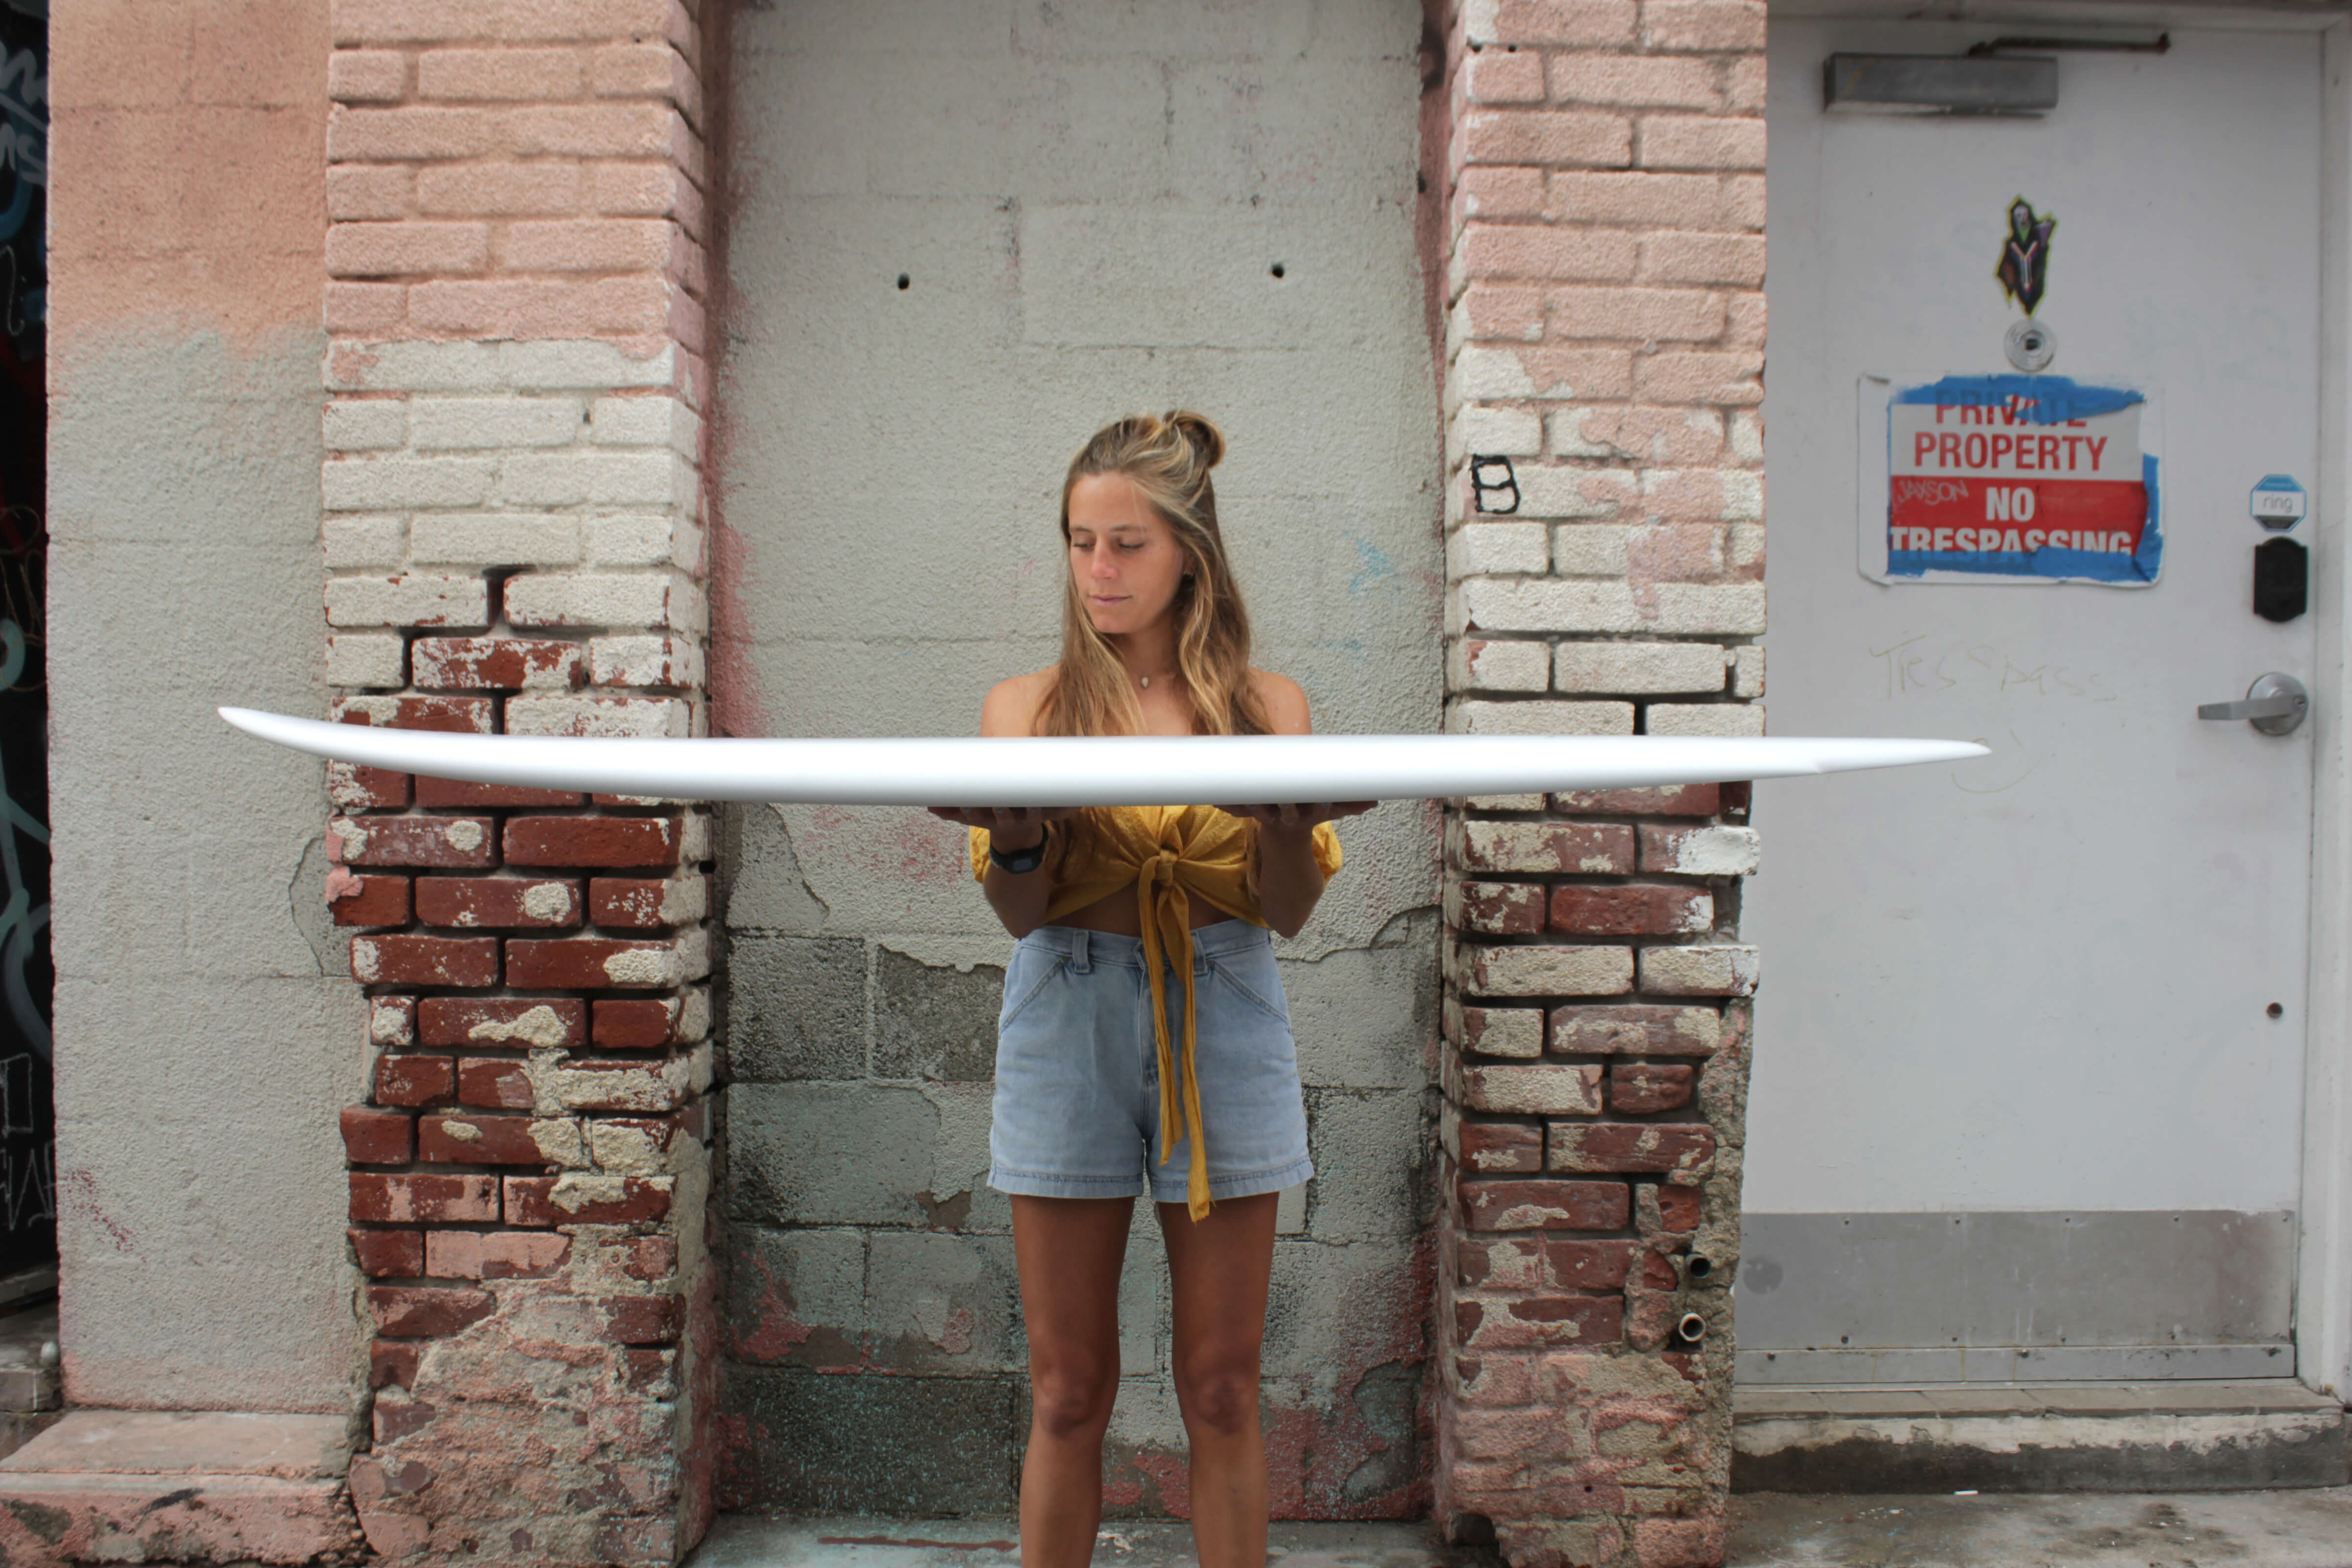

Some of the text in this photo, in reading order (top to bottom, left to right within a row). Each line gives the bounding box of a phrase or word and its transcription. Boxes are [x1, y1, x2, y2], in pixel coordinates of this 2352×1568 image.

[1914, 432, 2108, 471] PROPERTY
[1985, 487, 2035, 522] NO
[2262, 494, 2294, 514] ring
